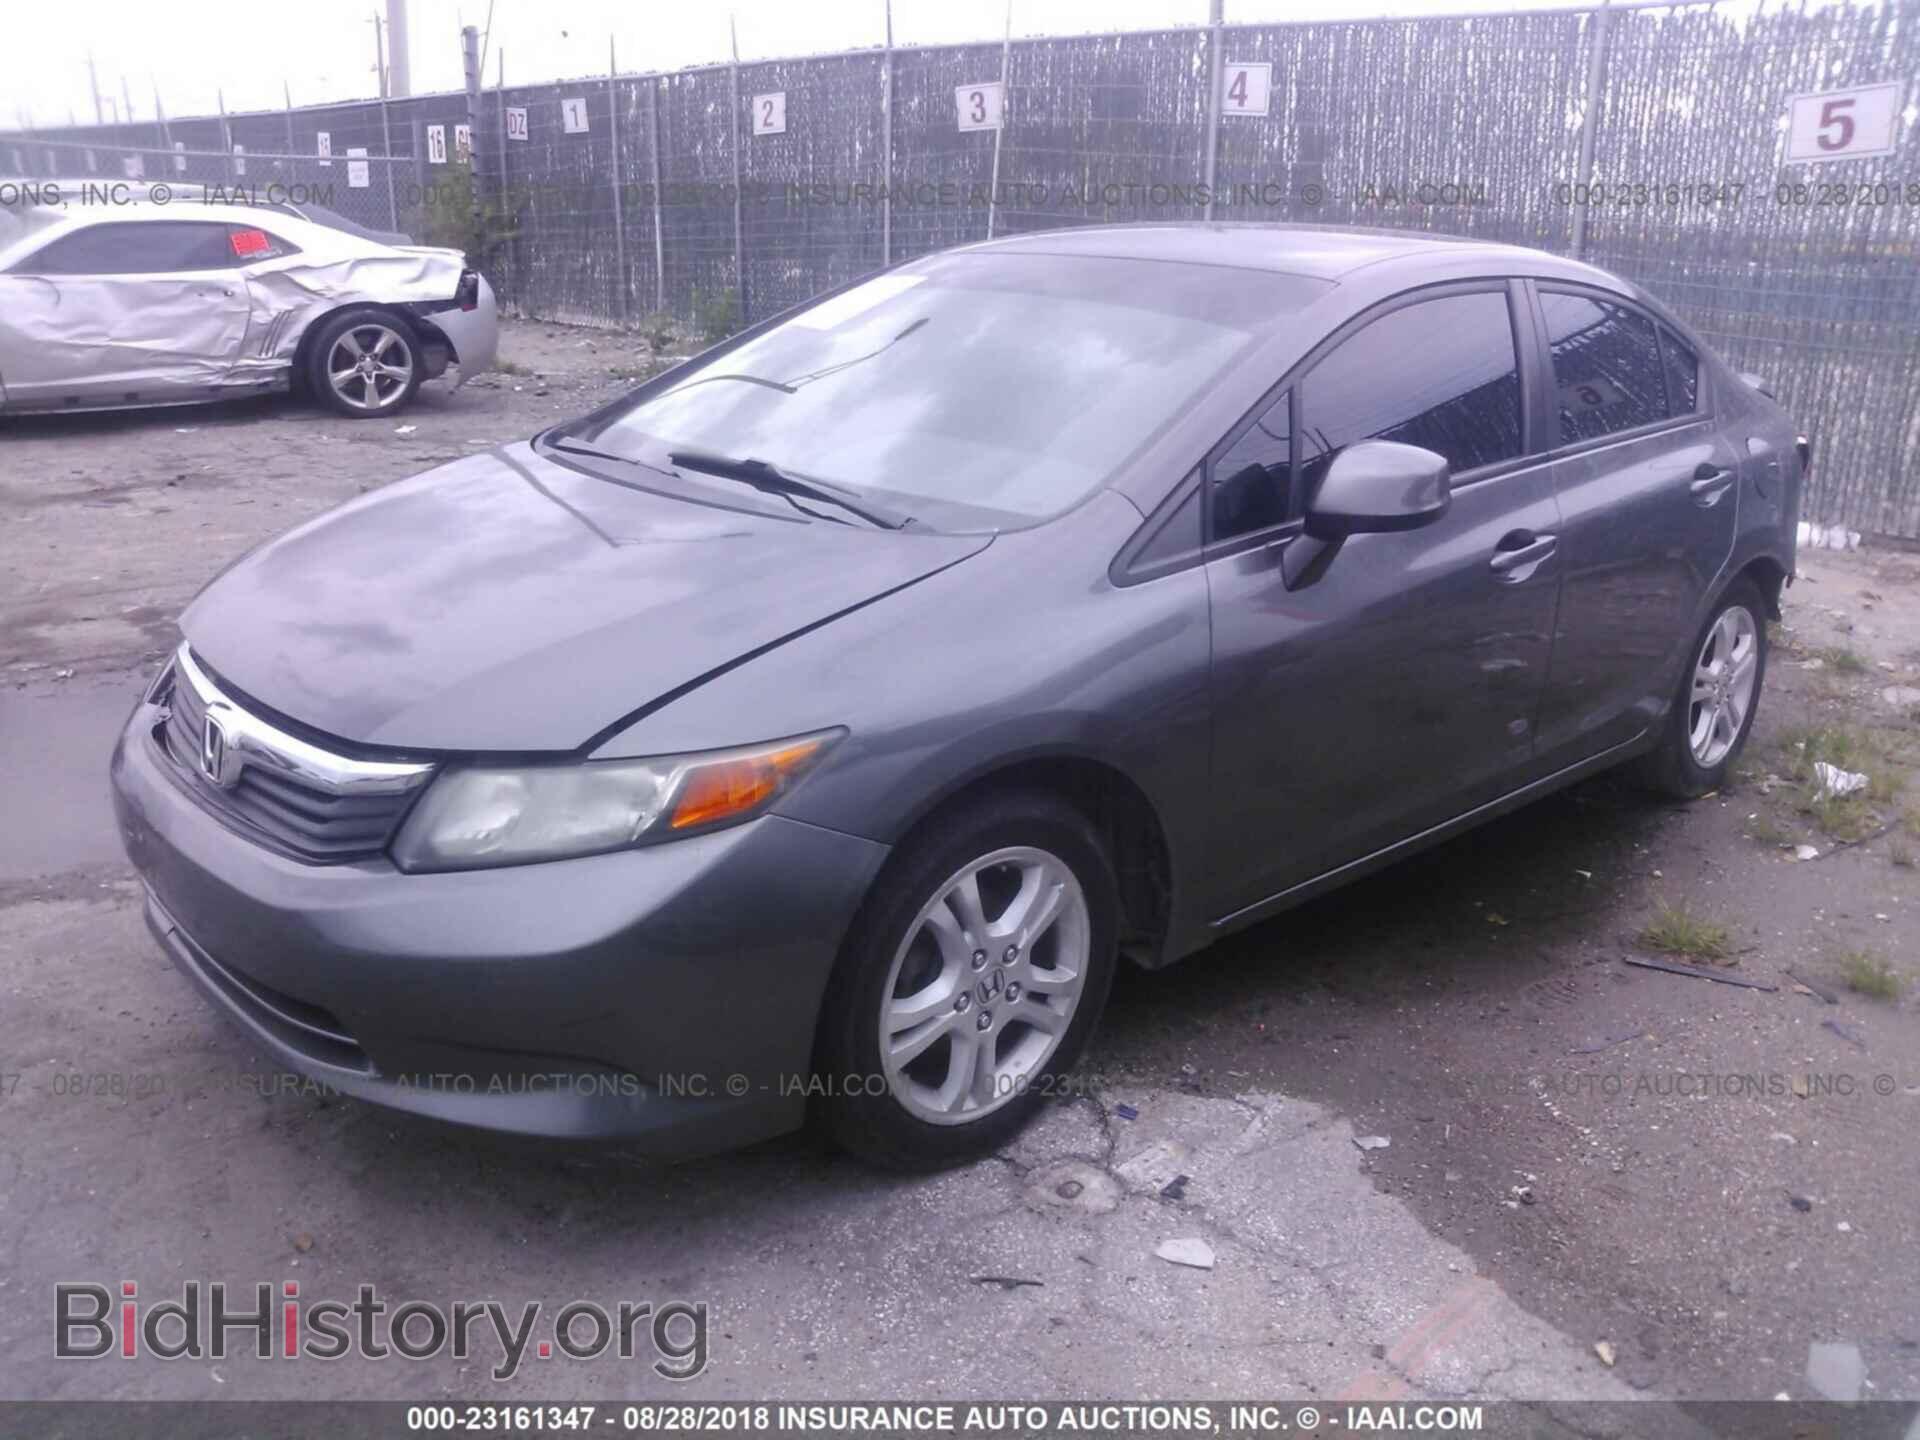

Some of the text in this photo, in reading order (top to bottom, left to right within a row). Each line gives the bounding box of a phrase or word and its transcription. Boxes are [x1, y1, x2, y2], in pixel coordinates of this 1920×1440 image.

[1228, 71, 1248, 107] 4
[568, 104, 579, 128] 1
[762, 100, 775, 128] 2
[970, 91, 986, 123] 3
[1817, 98, 1856, 152] 5
